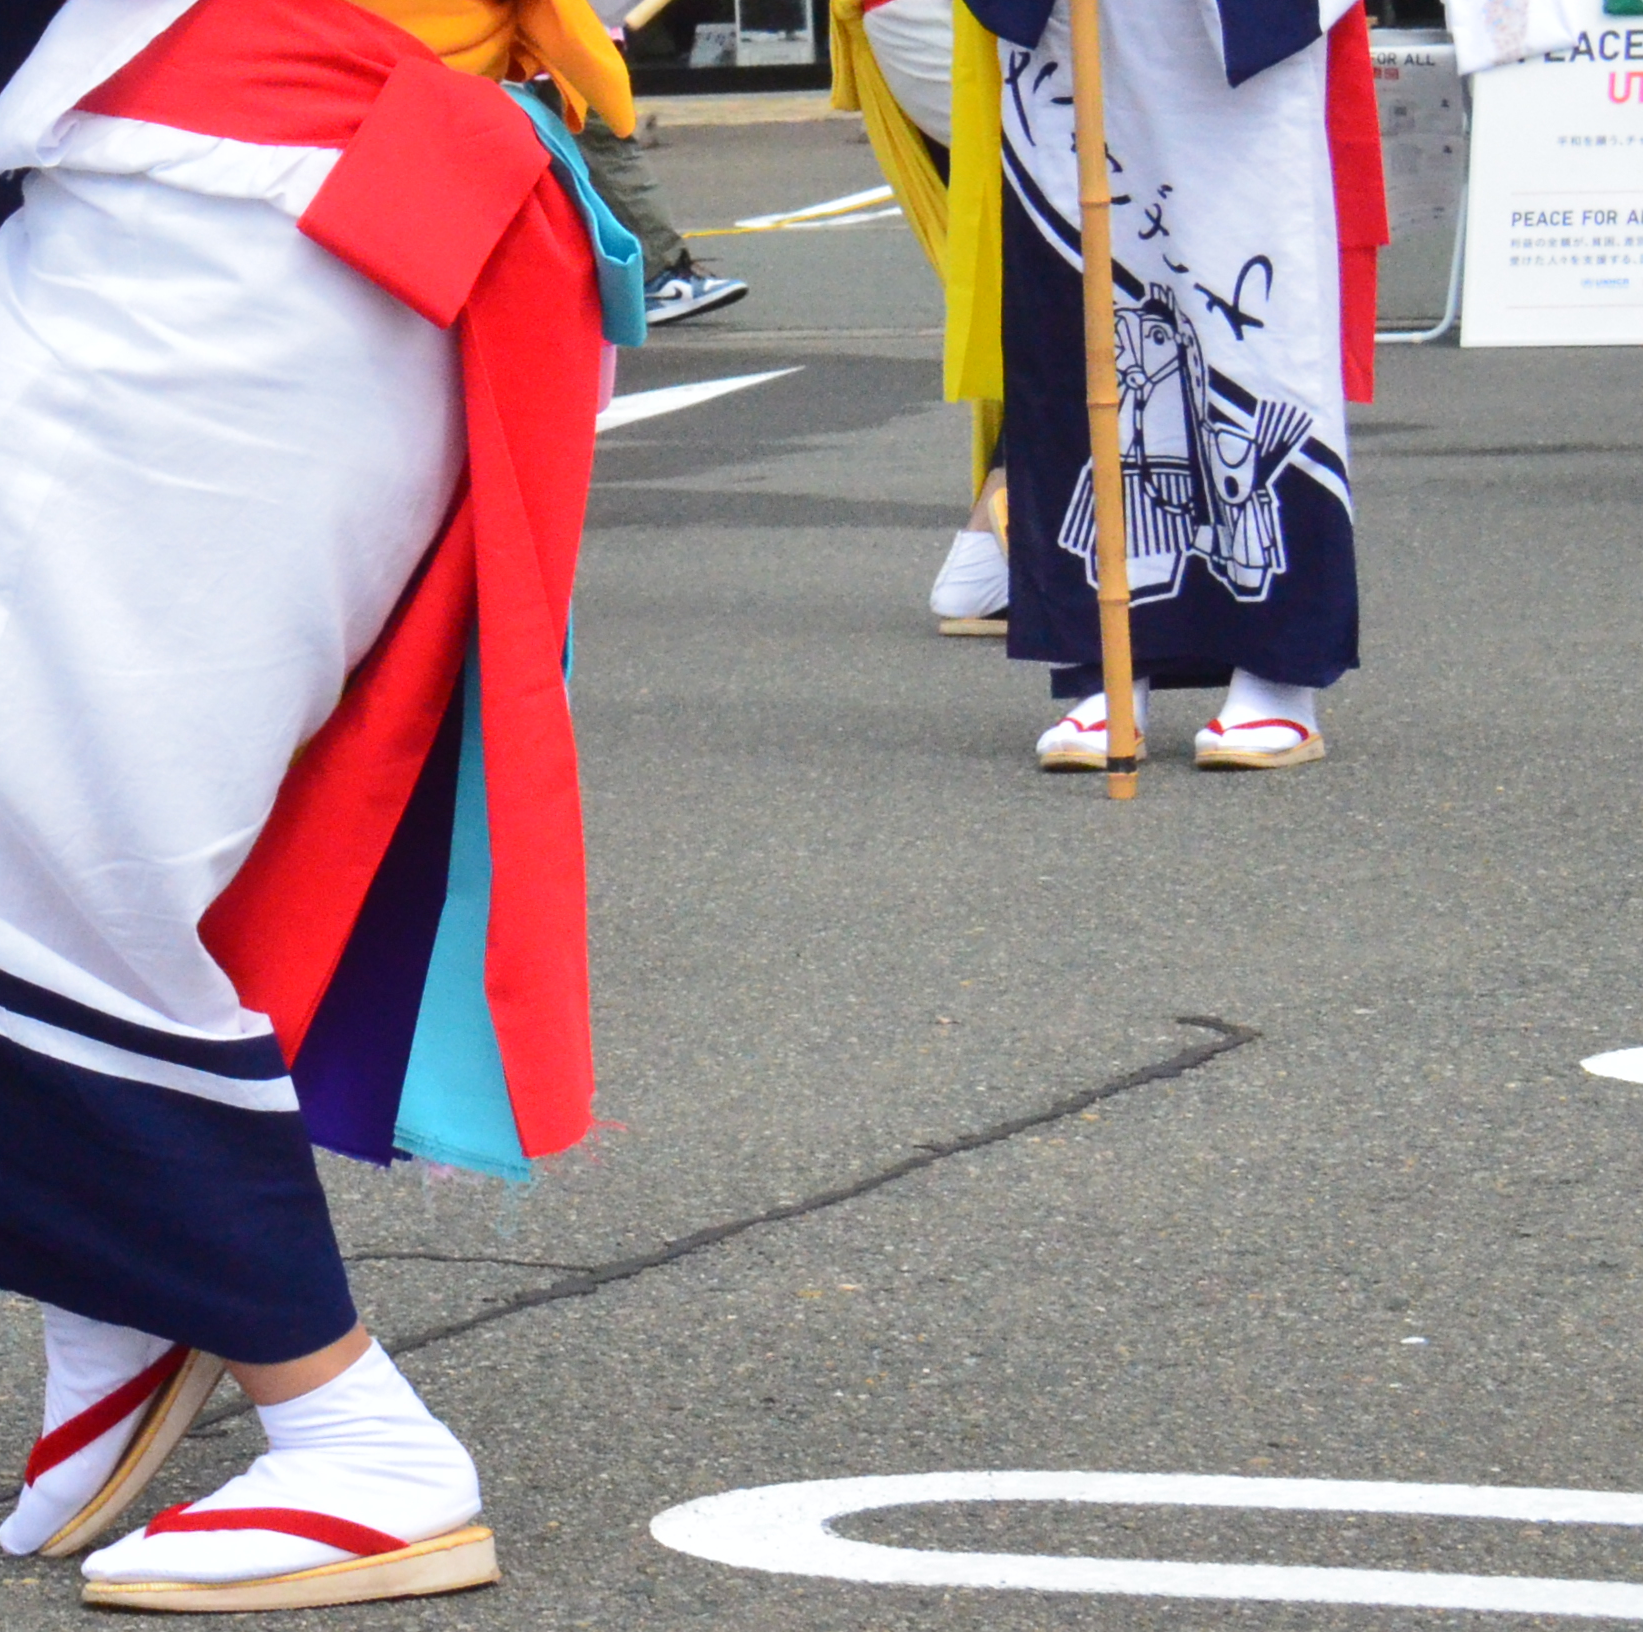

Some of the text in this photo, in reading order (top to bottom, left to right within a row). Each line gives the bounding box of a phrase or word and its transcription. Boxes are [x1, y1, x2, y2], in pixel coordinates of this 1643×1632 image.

[1516, 29, 1643, 64] ACE
[1404, 52, 1436, 66] ALL
[1511, 209, 1643, 227] PEACE FOR A
